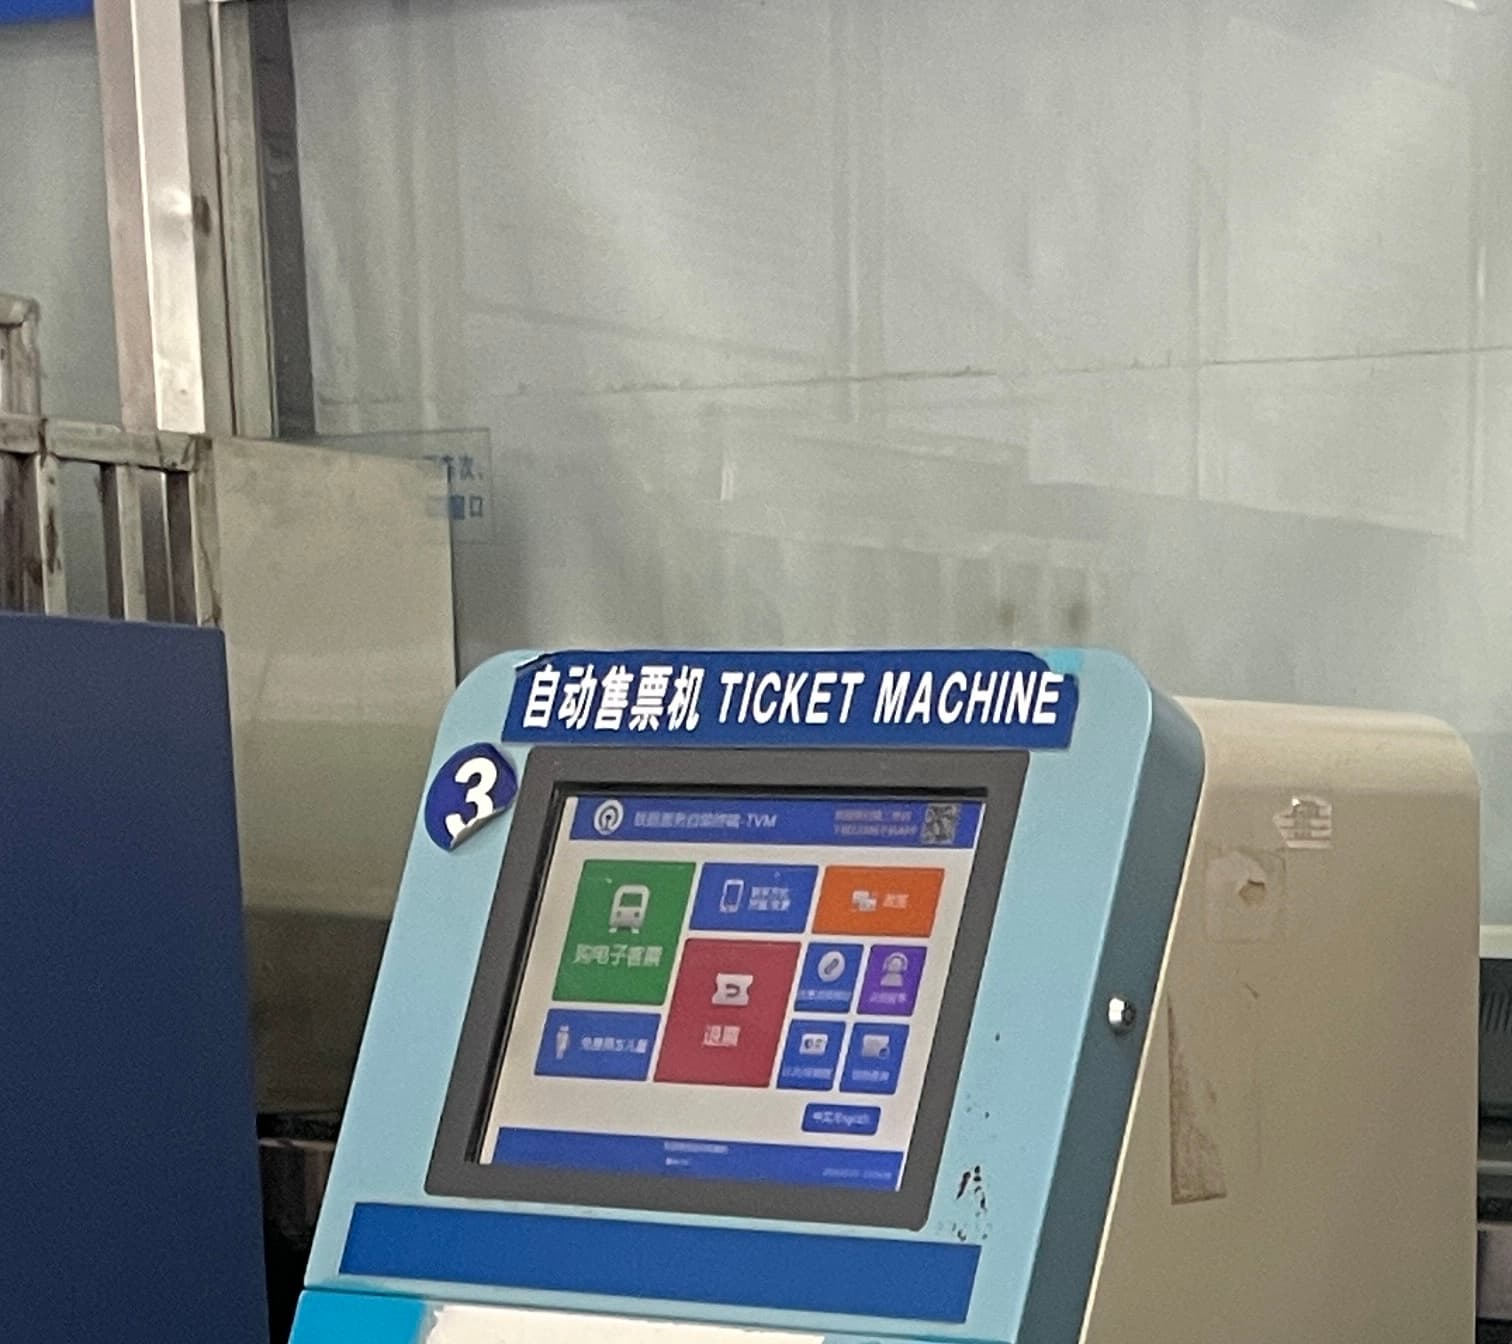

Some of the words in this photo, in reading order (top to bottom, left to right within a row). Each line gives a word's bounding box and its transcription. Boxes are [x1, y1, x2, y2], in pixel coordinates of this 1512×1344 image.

[522, 664, 705, 731] 自动售票机
[717, 671, 864, 724] TICKET
[873, 671, 1064, 726] MACHINE
[448, 757, 497, 836] 3
